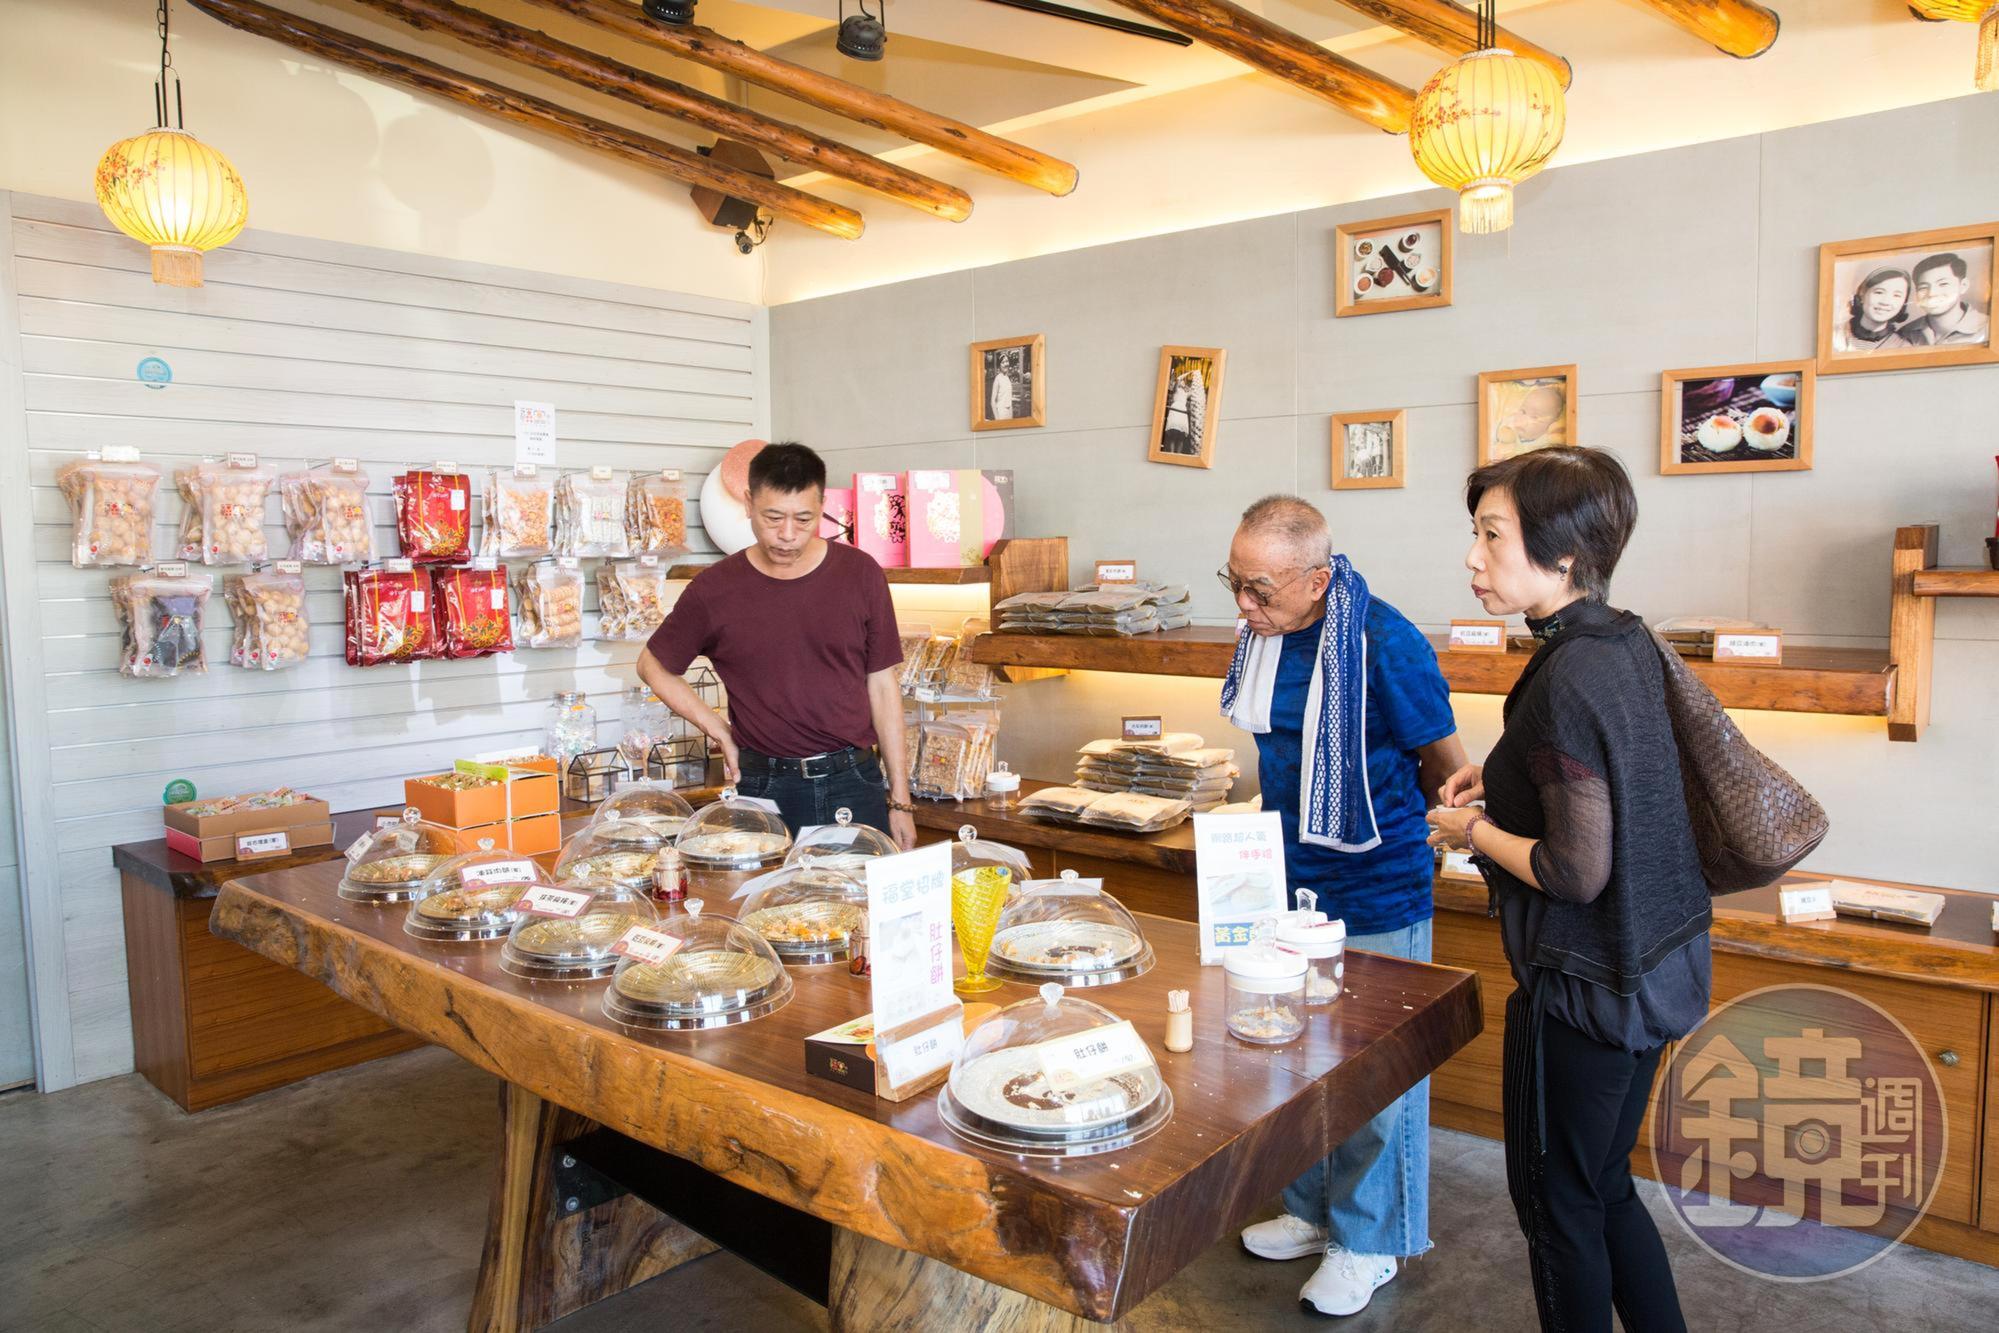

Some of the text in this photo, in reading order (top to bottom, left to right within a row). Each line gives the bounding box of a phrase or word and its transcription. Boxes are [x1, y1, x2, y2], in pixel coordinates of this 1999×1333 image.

[882, 870, 944, 904] 福堂招牌
[929, 921, 944, 985] 肚仔餅
[1074, 1040, 1109, 1059] 肚仔餅
